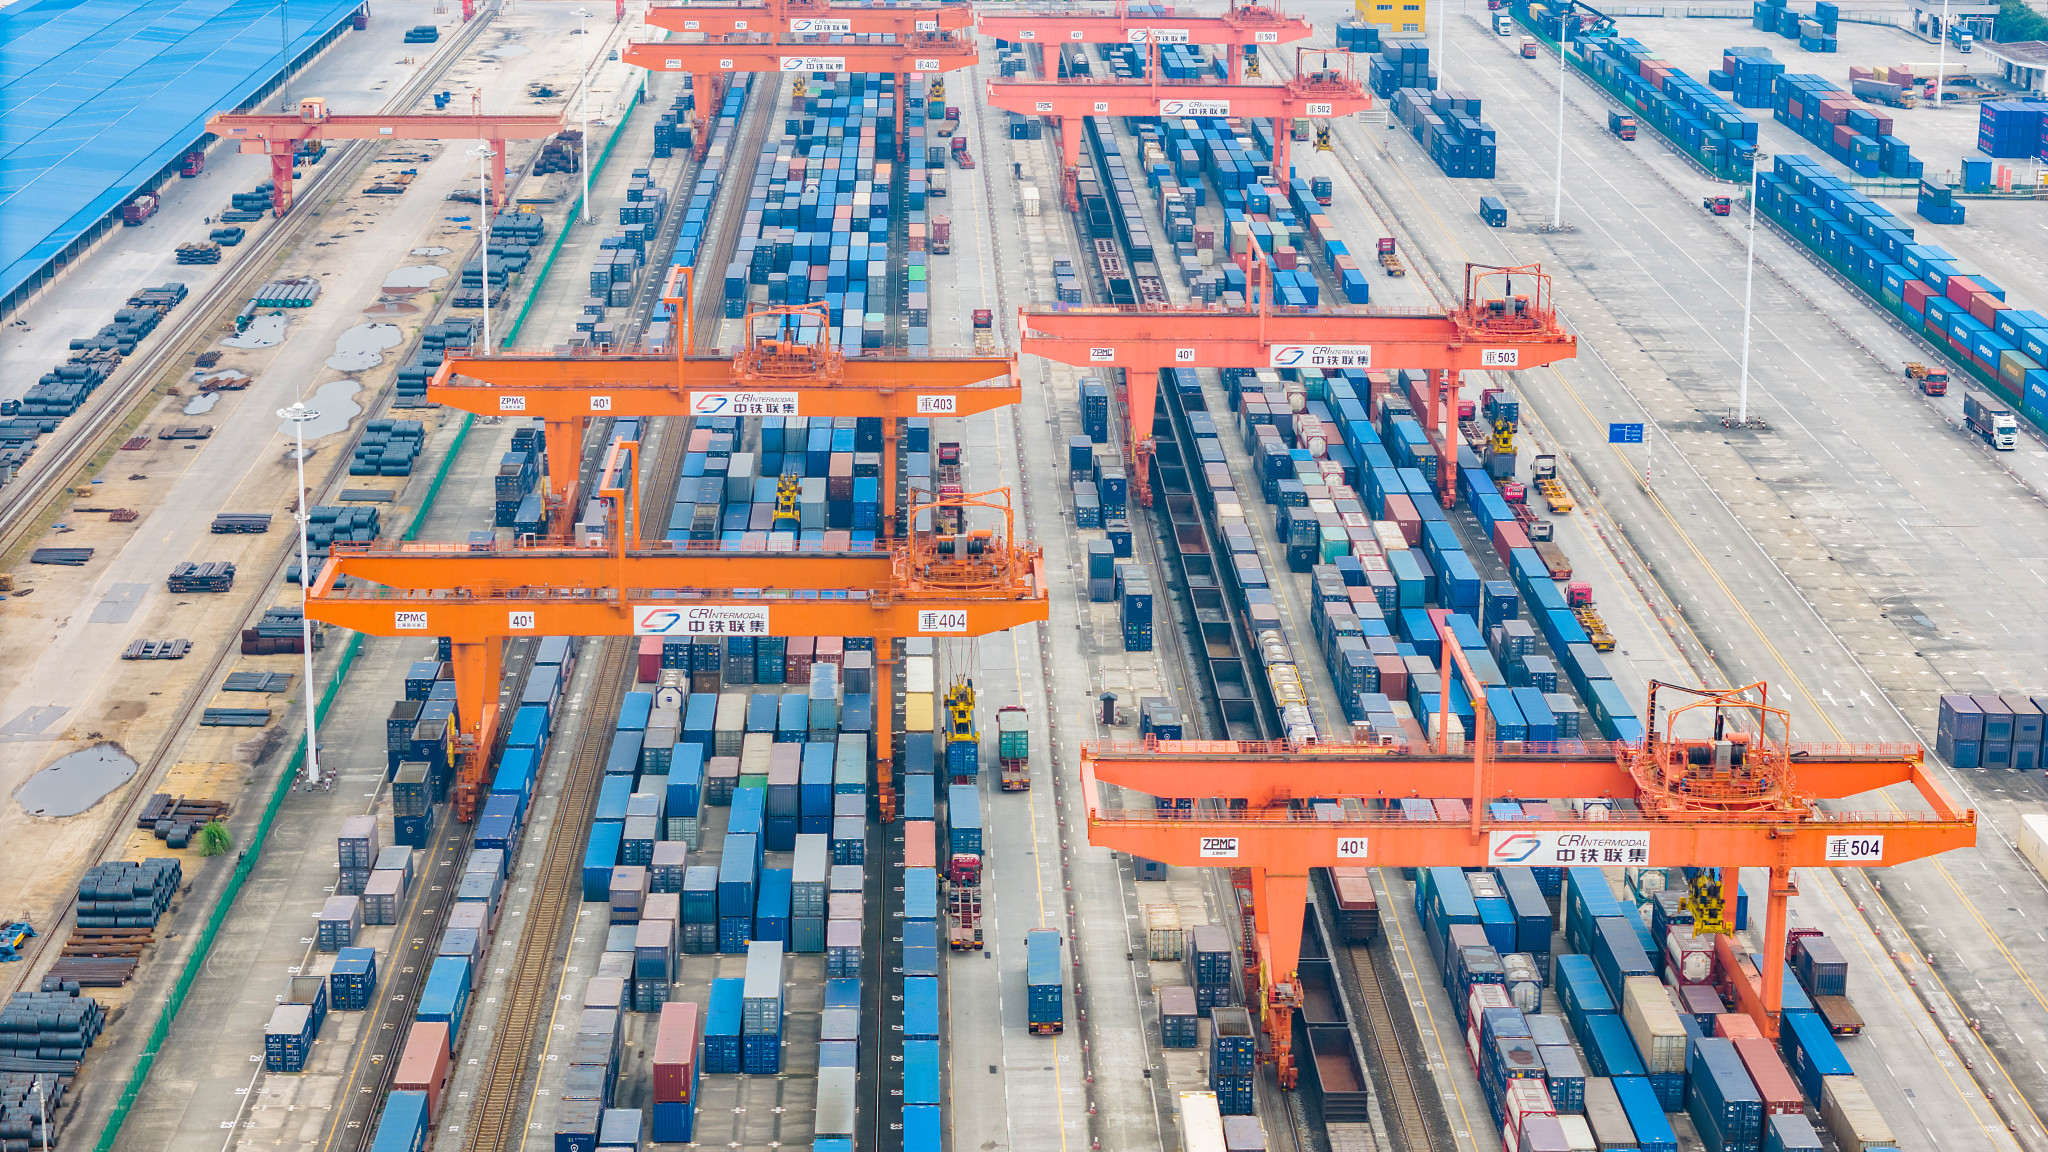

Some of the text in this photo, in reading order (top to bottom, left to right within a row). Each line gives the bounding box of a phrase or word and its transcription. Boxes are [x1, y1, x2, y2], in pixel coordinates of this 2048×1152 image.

[1092, 348, 1113, 356] ZPMC
[1484, 351, 1516, 363] 重503
[1312, 355, 1369, 365] 中铁联集
[733, 403, 795, 413] 中铁联集
[919, 397, 952, 411] 重403
[397, 613, 426, 621] ZPMC
[512, 615, 532, 627] 40t
[921, 612, 966, 629] 重404
[688, 620, 765, 632] 中铁联集
[1202, 838, 1236, 850] ZPMC
[1340, 840, 1364, 854] 40t
[1829, 838, 1880, 857] 重504
[1556, 848, 1647, 862] 中铁联集
